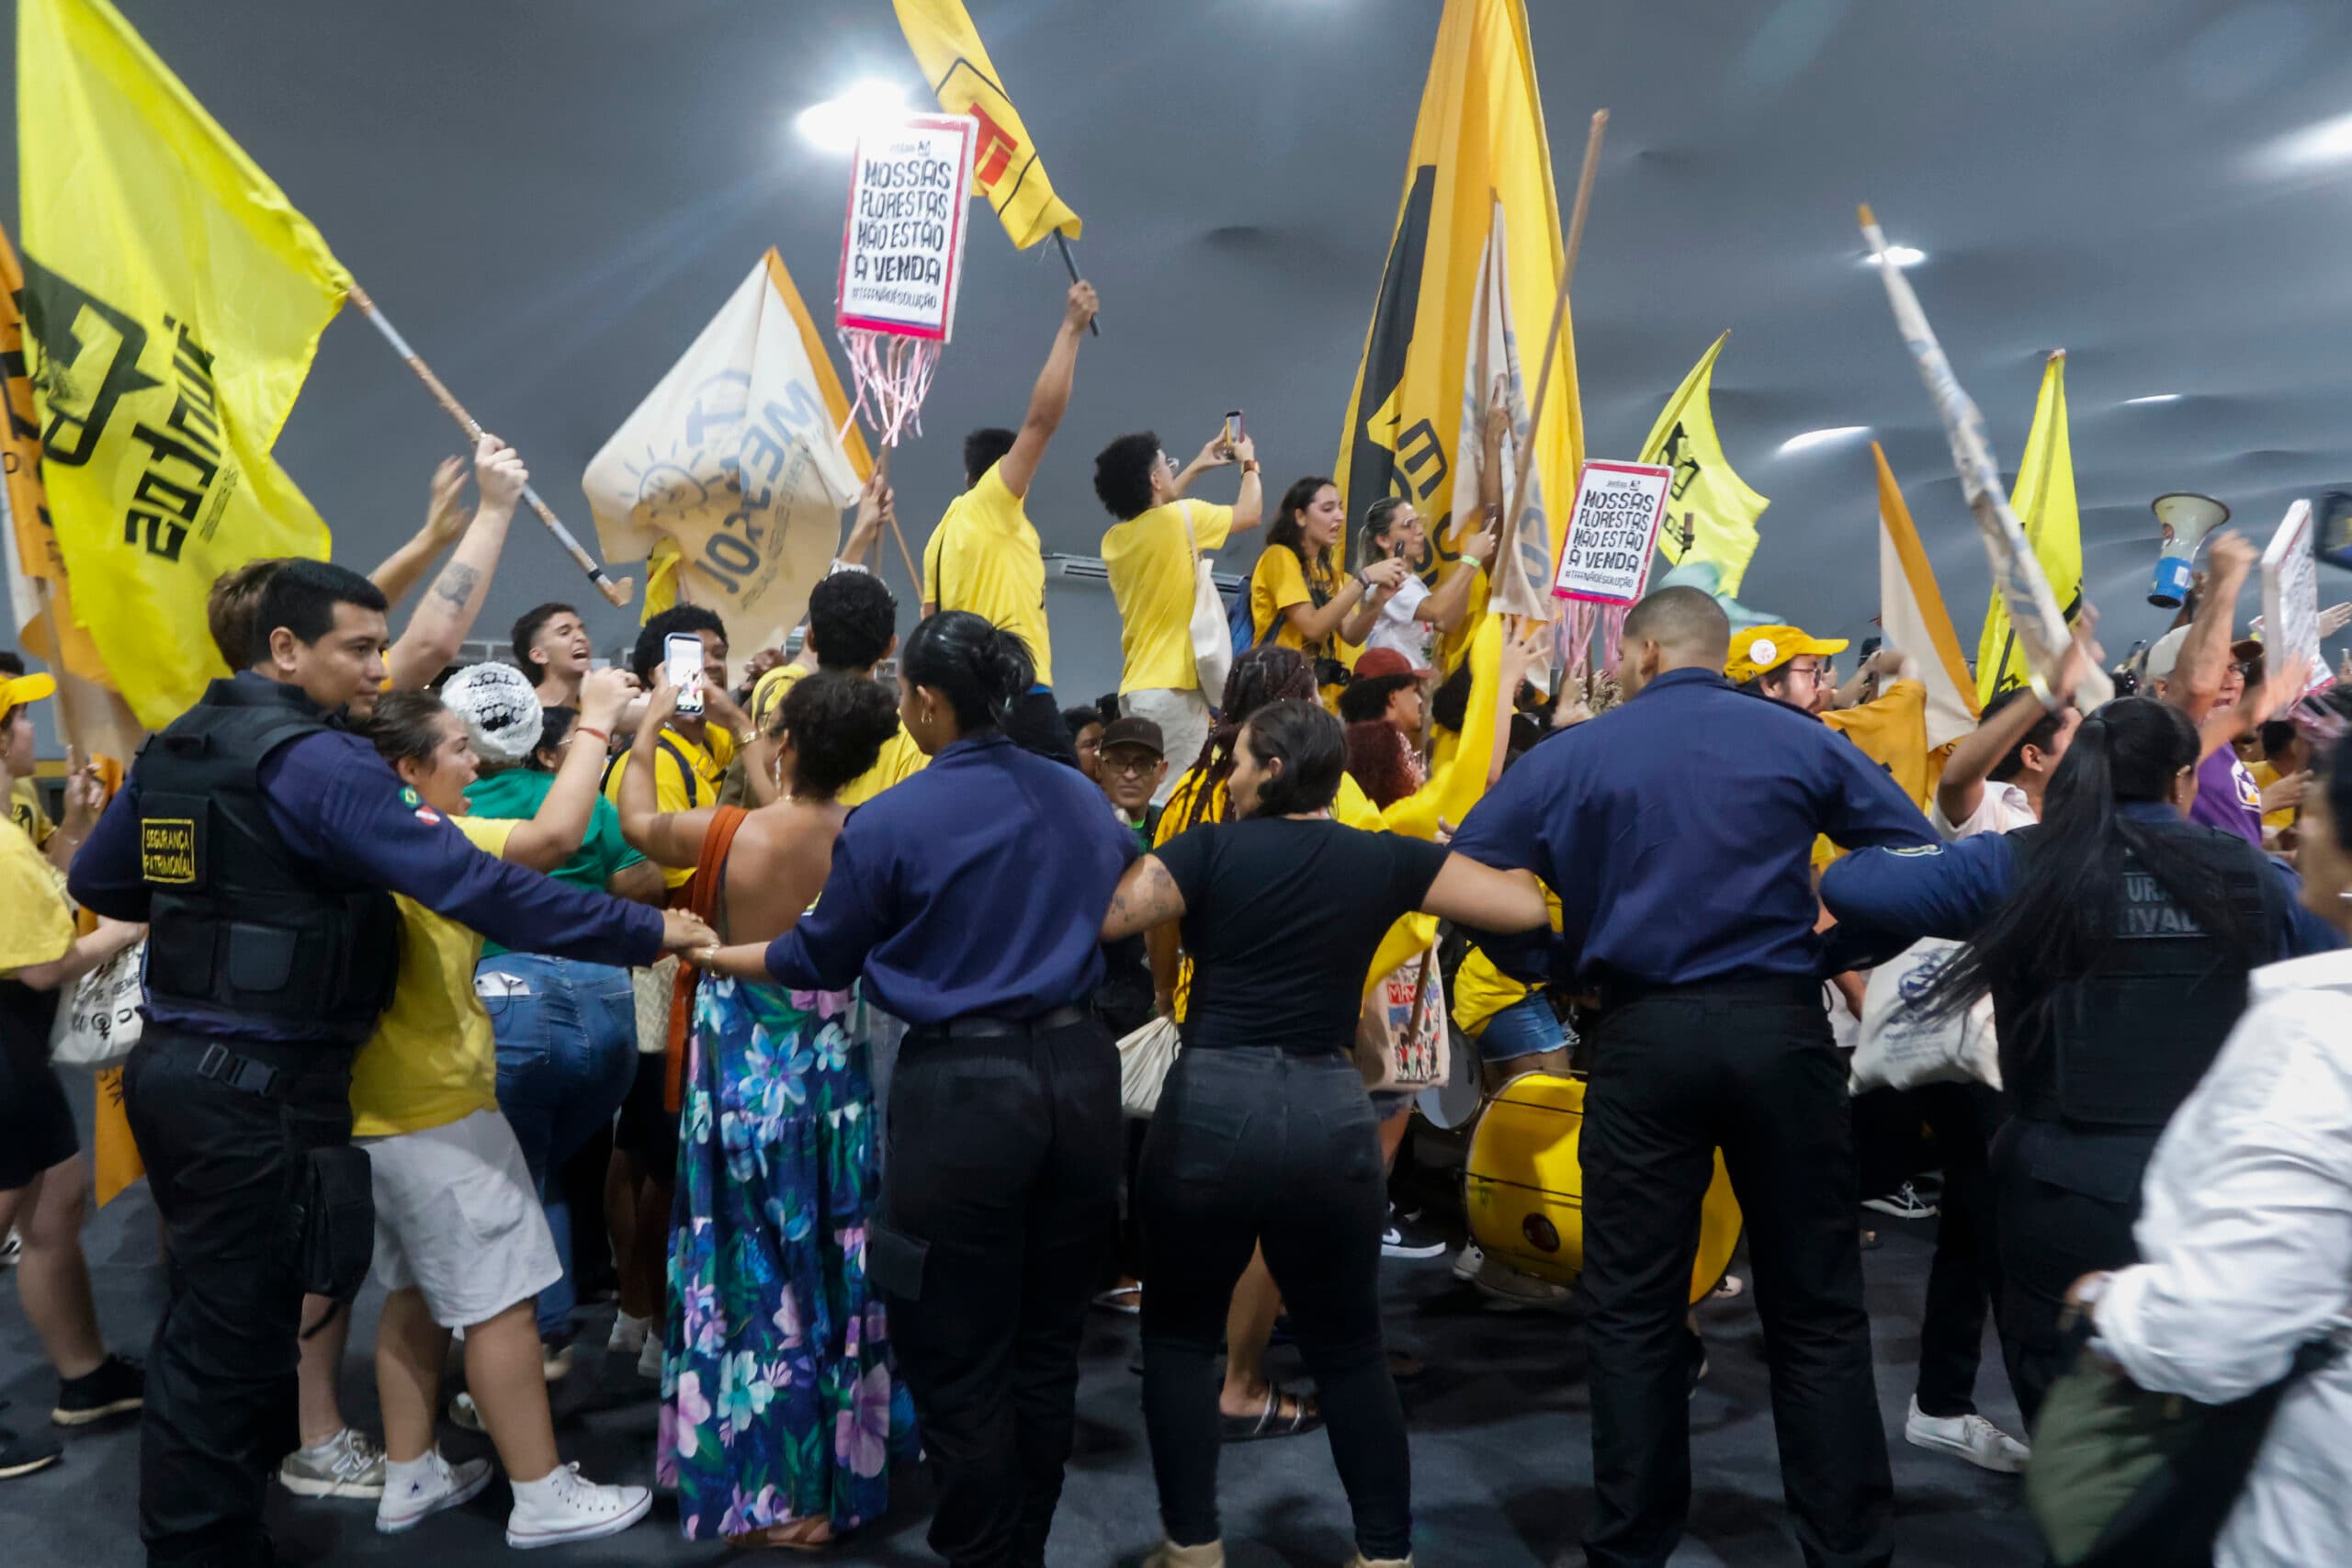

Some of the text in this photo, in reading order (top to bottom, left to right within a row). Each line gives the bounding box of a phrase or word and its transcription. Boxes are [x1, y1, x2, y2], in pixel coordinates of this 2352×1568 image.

[864, 158, 952, 189] NOSSAS
[860, 189, 948, 220] FLORESTAS
[857, 217, 944, 252] NÃO ESTÃO
[874, 255, 942, 286] VENDA
[1583, 490, 1655, 513] NOSSAS
[1577, 508, 1650, 533] FLORESTAS
[1573, 528, 1600, 548] NÃO
[1600, 528, 1645, 552] ESTÃO
[1567, 545, 1640, 573] À VENDA
[146, 829, 190, 852] SEGURANÇA
